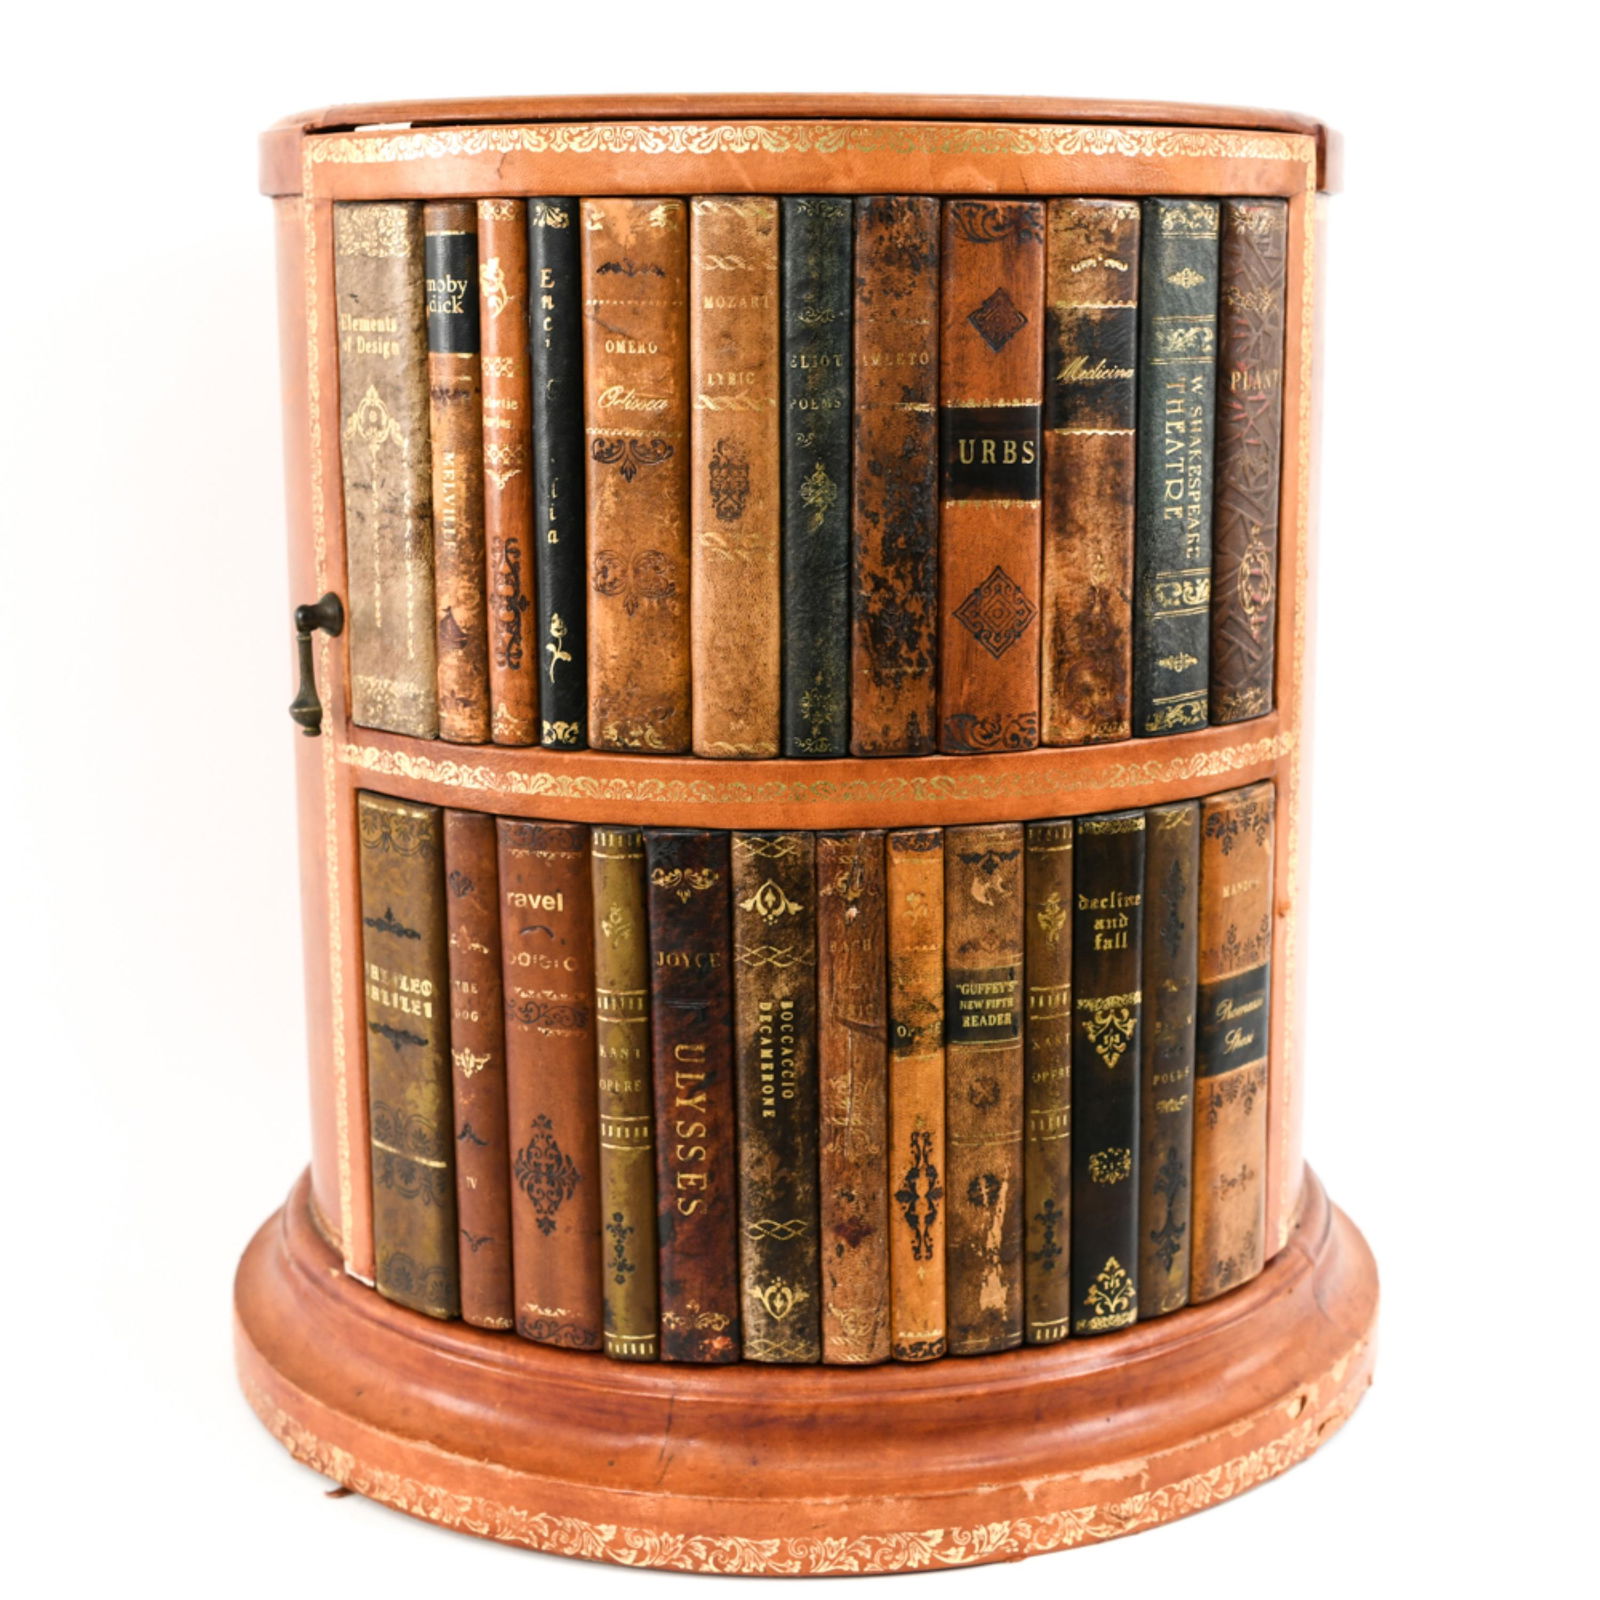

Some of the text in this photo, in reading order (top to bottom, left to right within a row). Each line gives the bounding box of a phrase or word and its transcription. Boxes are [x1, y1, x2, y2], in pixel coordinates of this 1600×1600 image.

[426, 274, 468, 299] moby
[429, 295, 465, 313] dick
[704, 295, 769, 309] MOZART
[341, 313, 397, 332] Elements
[357, 335, 400, 360] Design
[605, 339, 658, 354] OMERO
[789, 353, 844, 369] ELIOT
[1056, 355, 1136, 382] Medicina
[707, 371, 756, 386] LYRIC
[958, 438, 1036, 465] URBS
[1164, 377, 1187, 521] THEATRE
[1185, 404, 1204, 560] SHAKESPEARE
[1077, 891, 1142, 911] decline
[1093, 912, 1130, 931] and
[1093, 933, 1130, 951] fall
[656, 951, 721, 968] JOYCE
[959, 997, 1014, 1010] NEW FIFTH
[962, 1012, 1012, 1028] READER
[780, 1000, 795, 1100] BOCCACCIO
[758, 1001, 776, 1119] DECAMERONE
[598, 1078, 642, 1093] OPERE
[674, 1043, 708, 1217] ULYSSES
